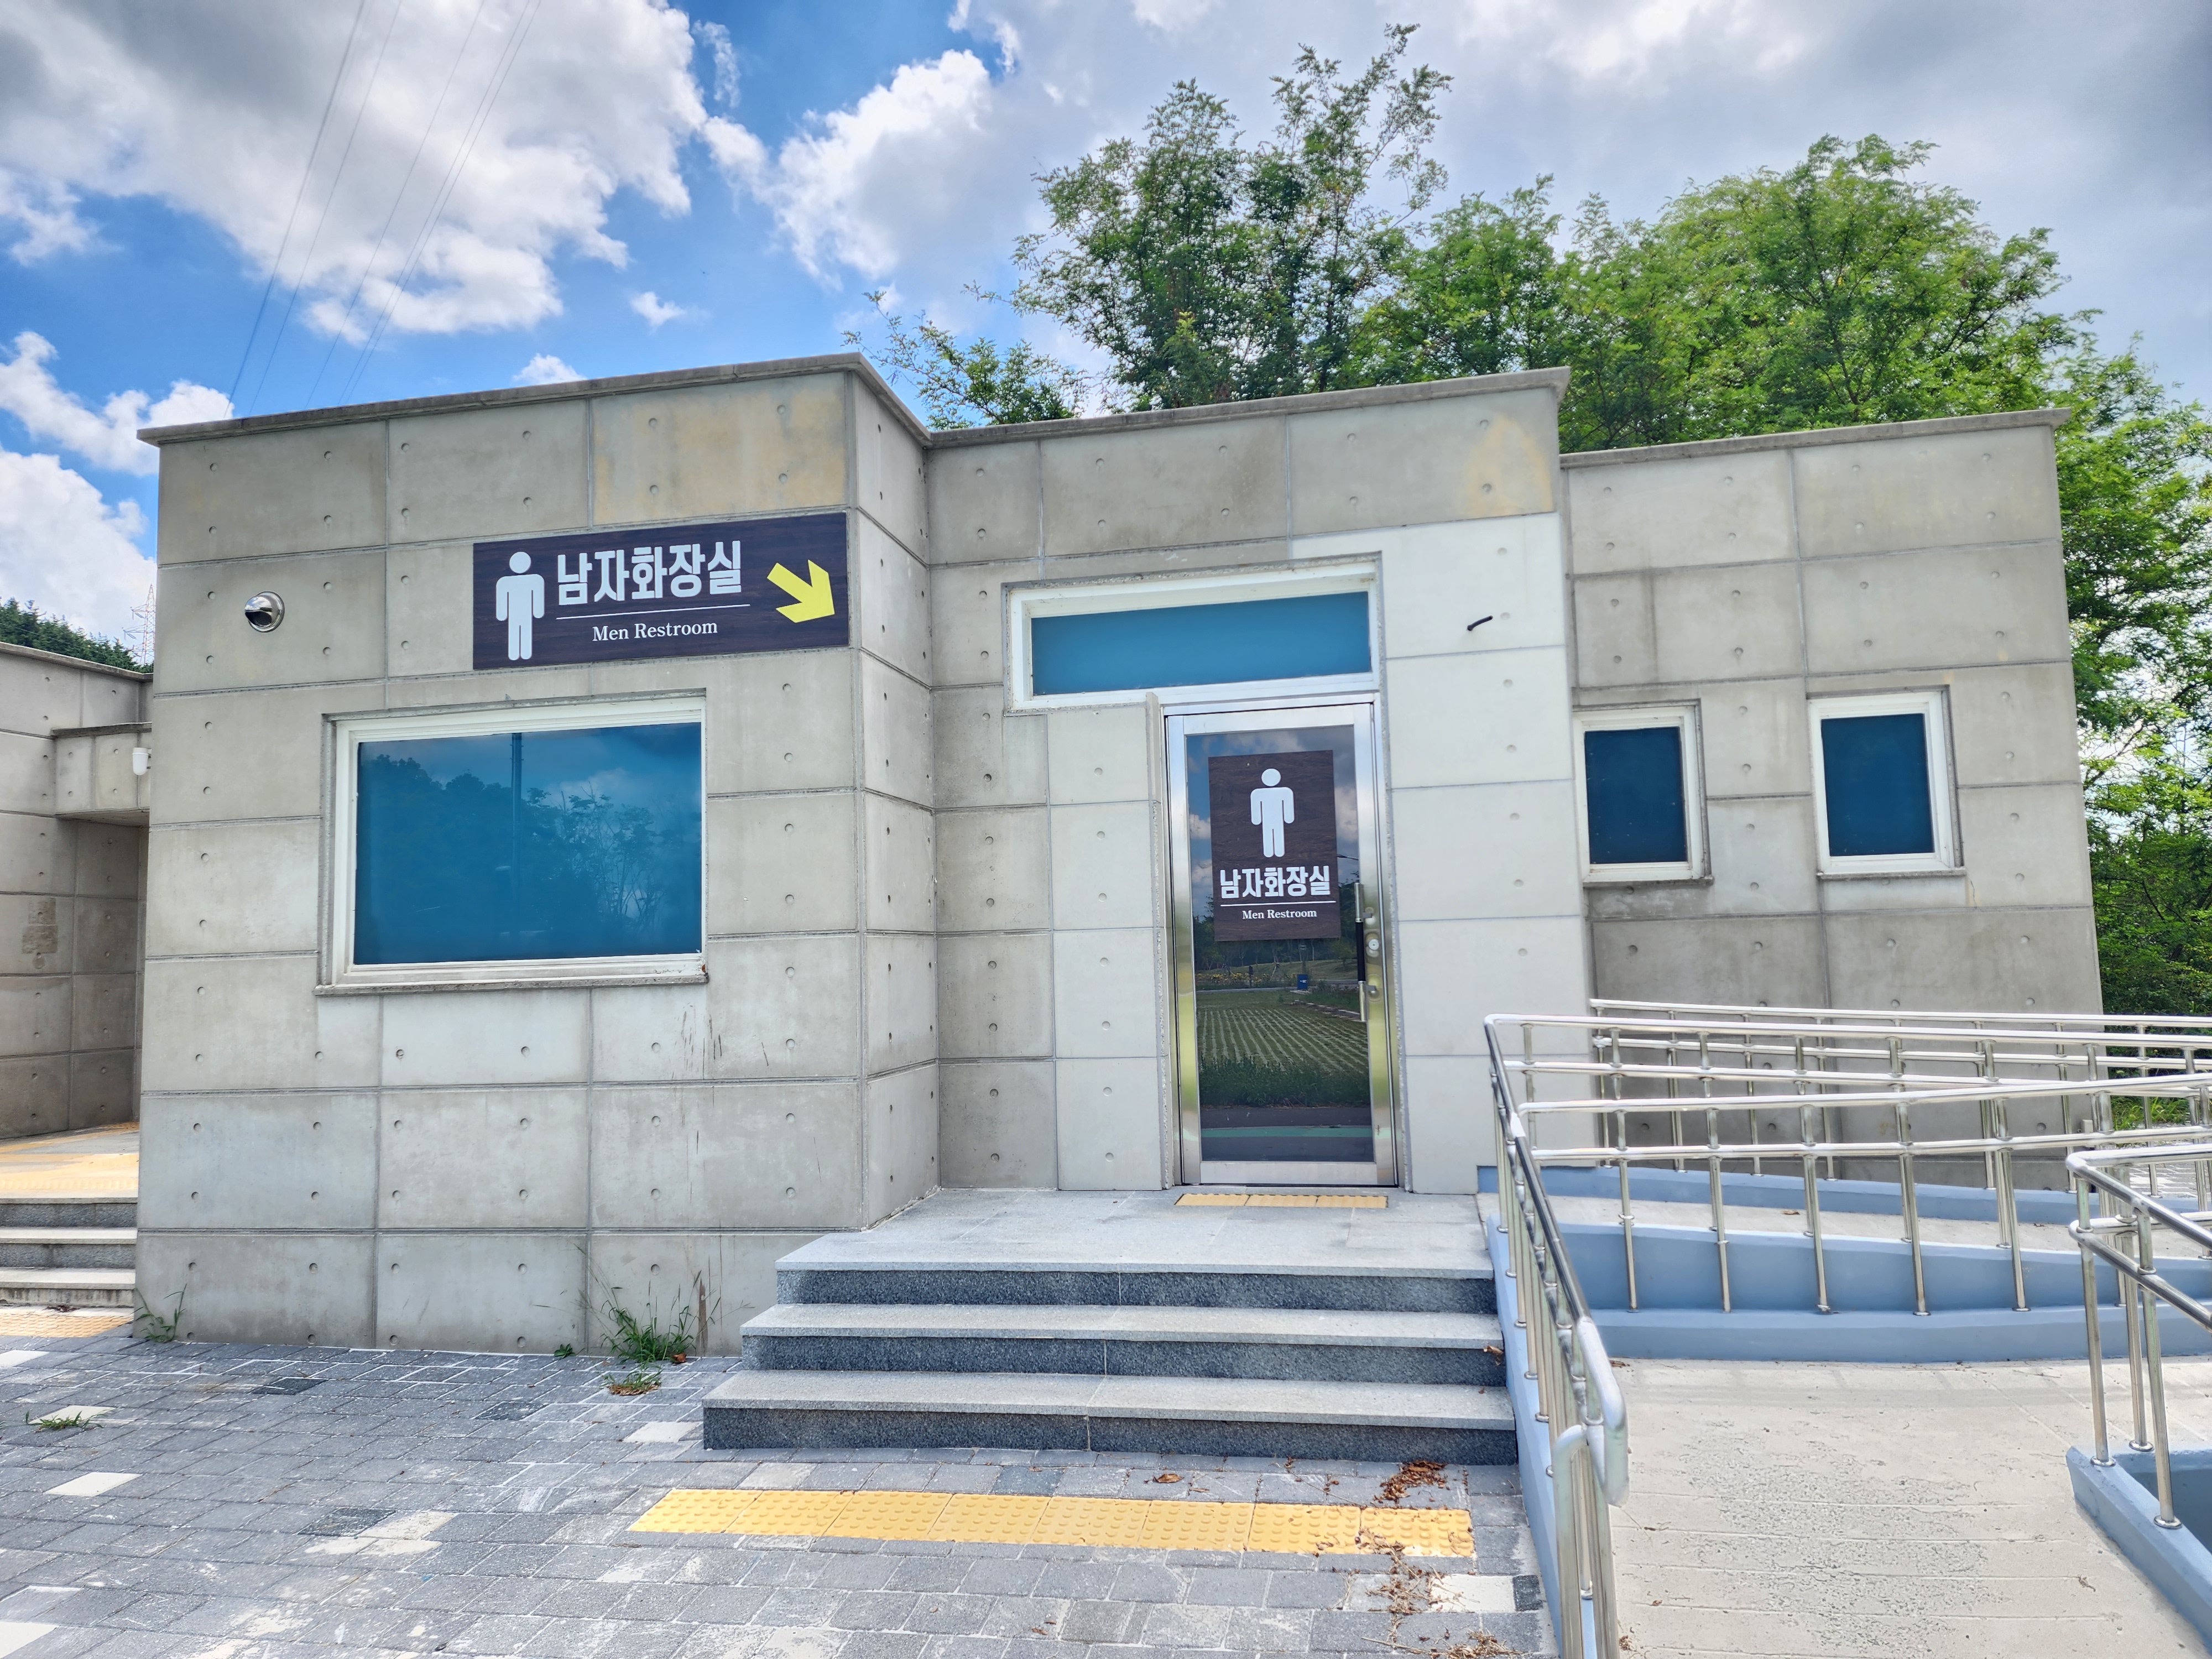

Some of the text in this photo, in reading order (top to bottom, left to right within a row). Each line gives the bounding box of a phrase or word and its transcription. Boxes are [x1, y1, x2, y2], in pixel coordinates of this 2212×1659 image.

[557, 540, 742, 606] 남자화장실
[592, 622, 718, 641] Men Restroom
[1220, 865, 1331, 899] 남자화장실
[1242, 909, 1317, 920] Men Restroom
